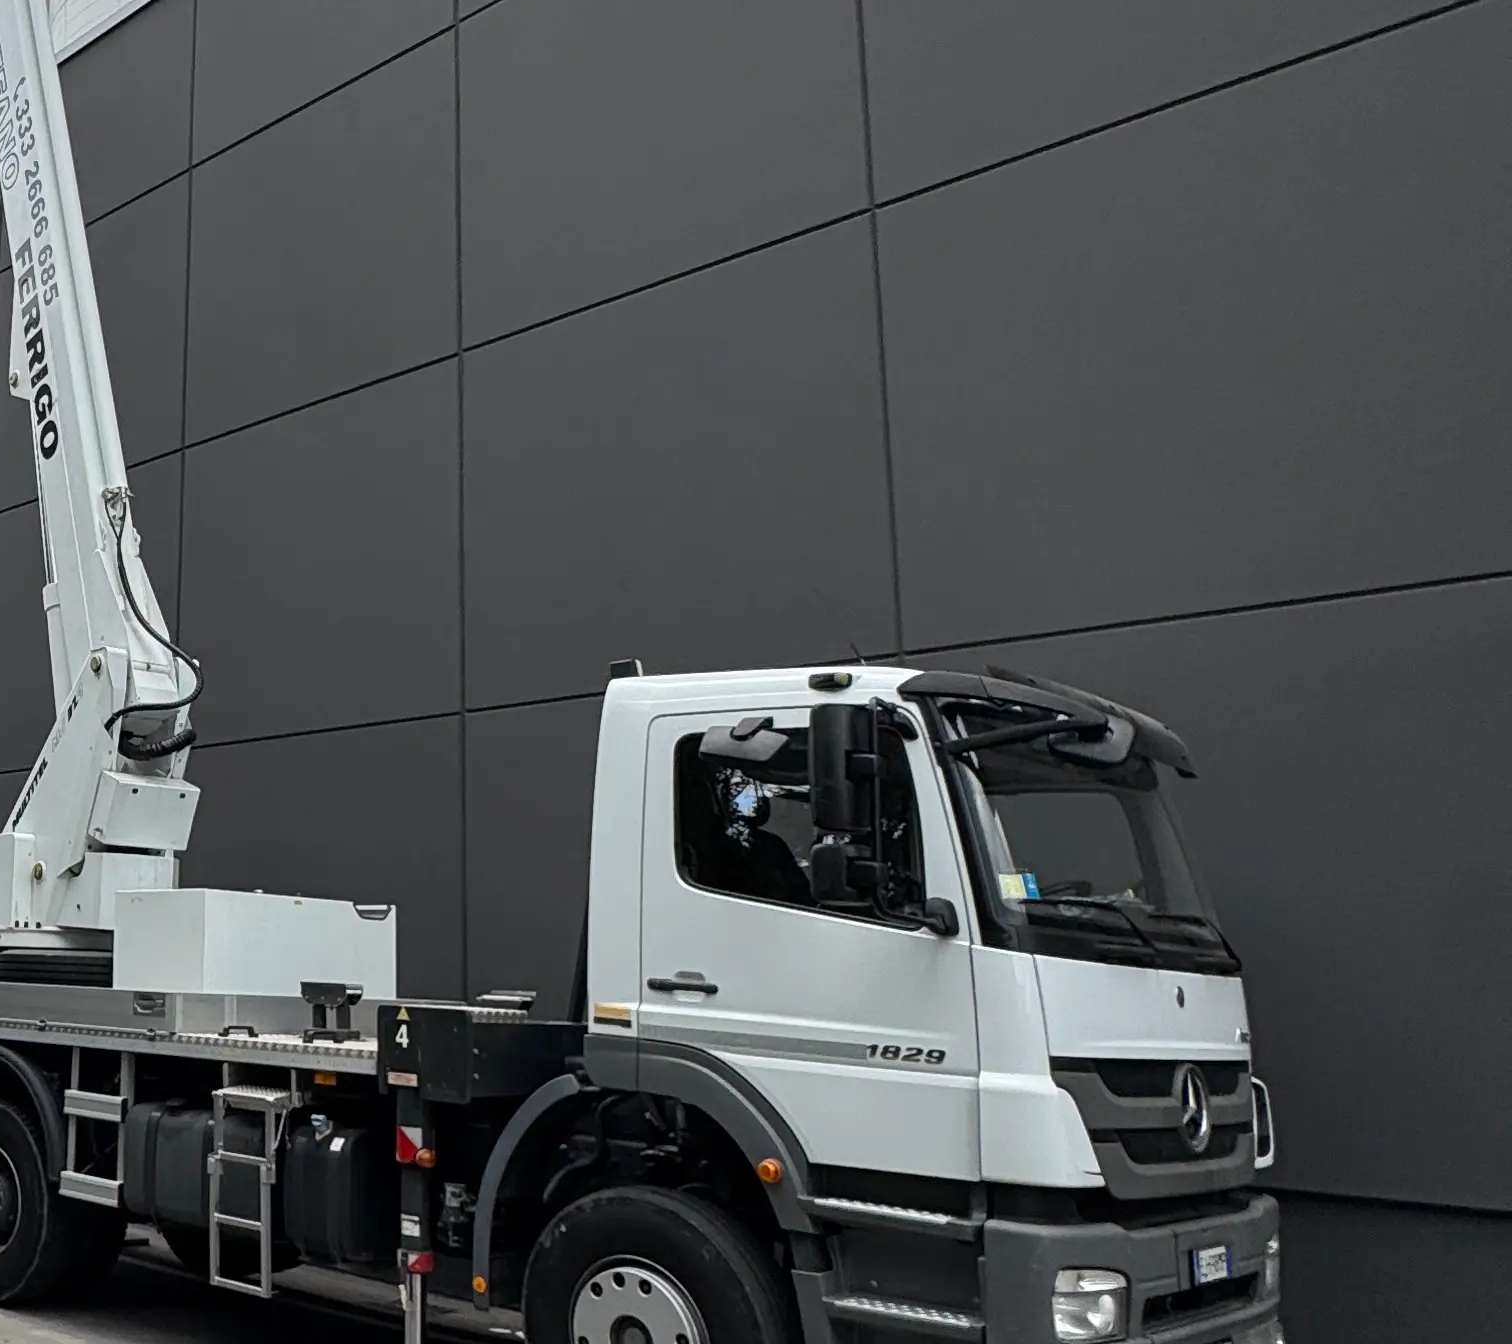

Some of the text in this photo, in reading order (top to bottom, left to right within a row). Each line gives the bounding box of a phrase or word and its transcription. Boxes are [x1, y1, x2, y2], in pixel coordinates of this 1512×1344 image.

[16, 99, 59, 306] 333 2666 685
[15, 236, 58, 460] FERRIGO
[395, 1024, 409, 1048] 4
[867, 1044, 946, 1064] 1829
